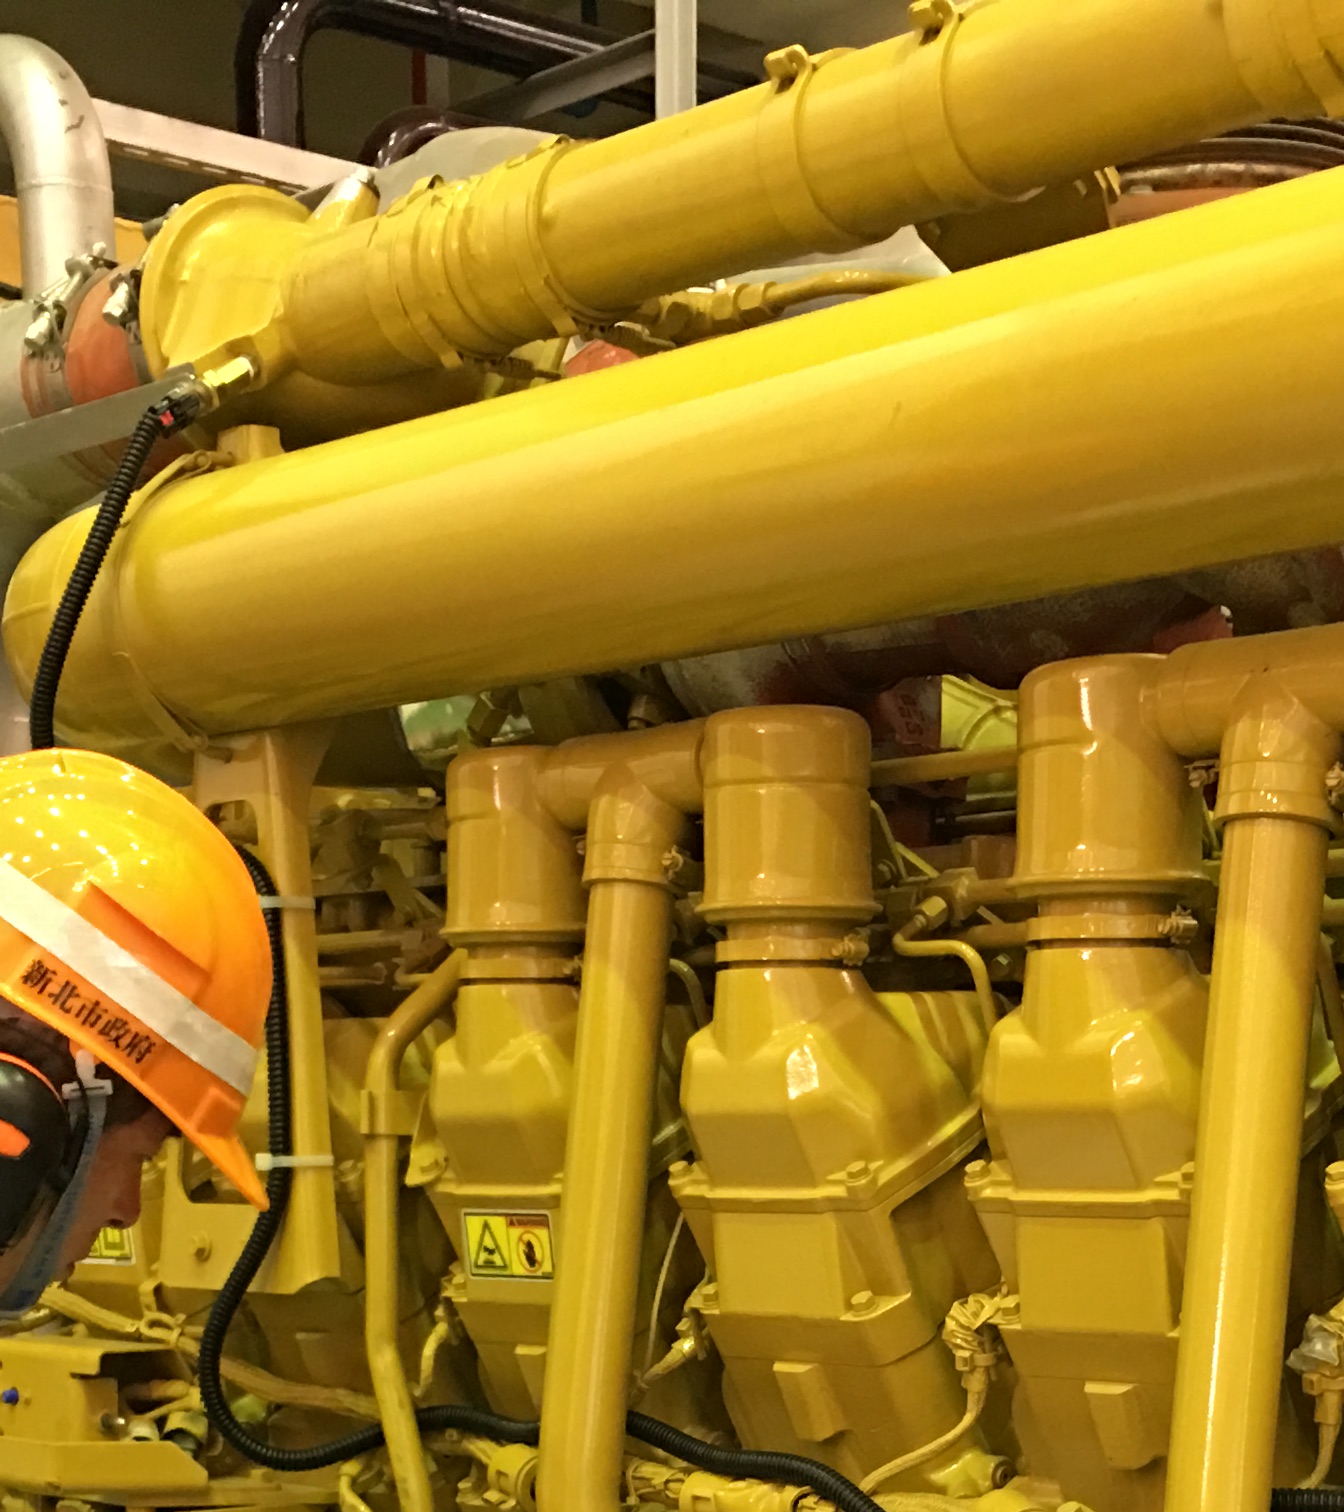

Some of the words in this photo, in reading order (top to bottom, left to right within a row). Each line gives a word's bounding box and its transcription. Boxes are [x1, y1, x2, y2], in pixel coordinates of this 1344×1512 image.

[21, 959, 156, 1065] 新北市政府
